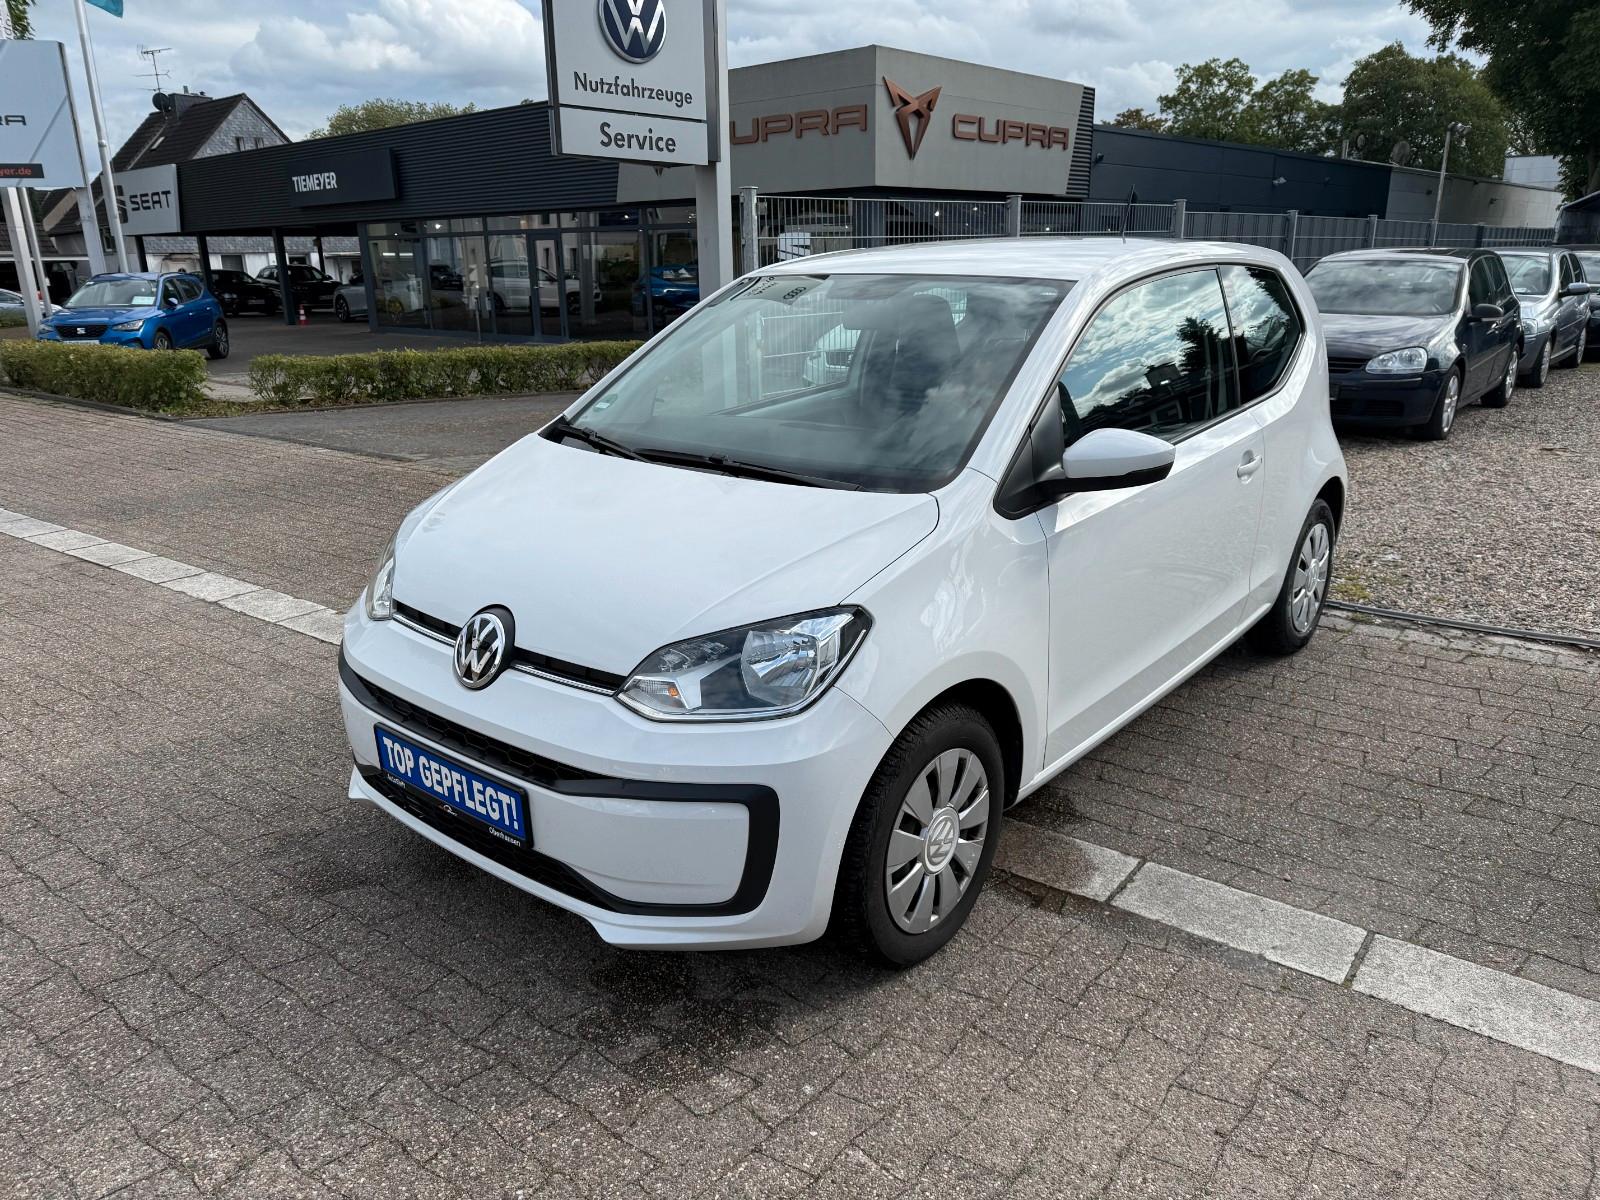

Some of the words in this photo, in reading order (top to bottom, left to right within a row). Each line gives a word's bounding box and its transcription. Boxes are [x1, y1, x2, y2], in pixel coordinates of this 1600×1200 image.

[573, 71, 693, 108] Nutzfahrzeuge
[599, 122, 677, 153] Service
[730, 104, 868, 145] UPRA
[952, 113, 1070, 151] CUPRA
[292, 171, 338, 193] TIEMEYER
[129, 190, 171, 212] SEAT
[382, 735, 415, 778] TOP
[418, 755, 519, 831] GEPFLEGT!
